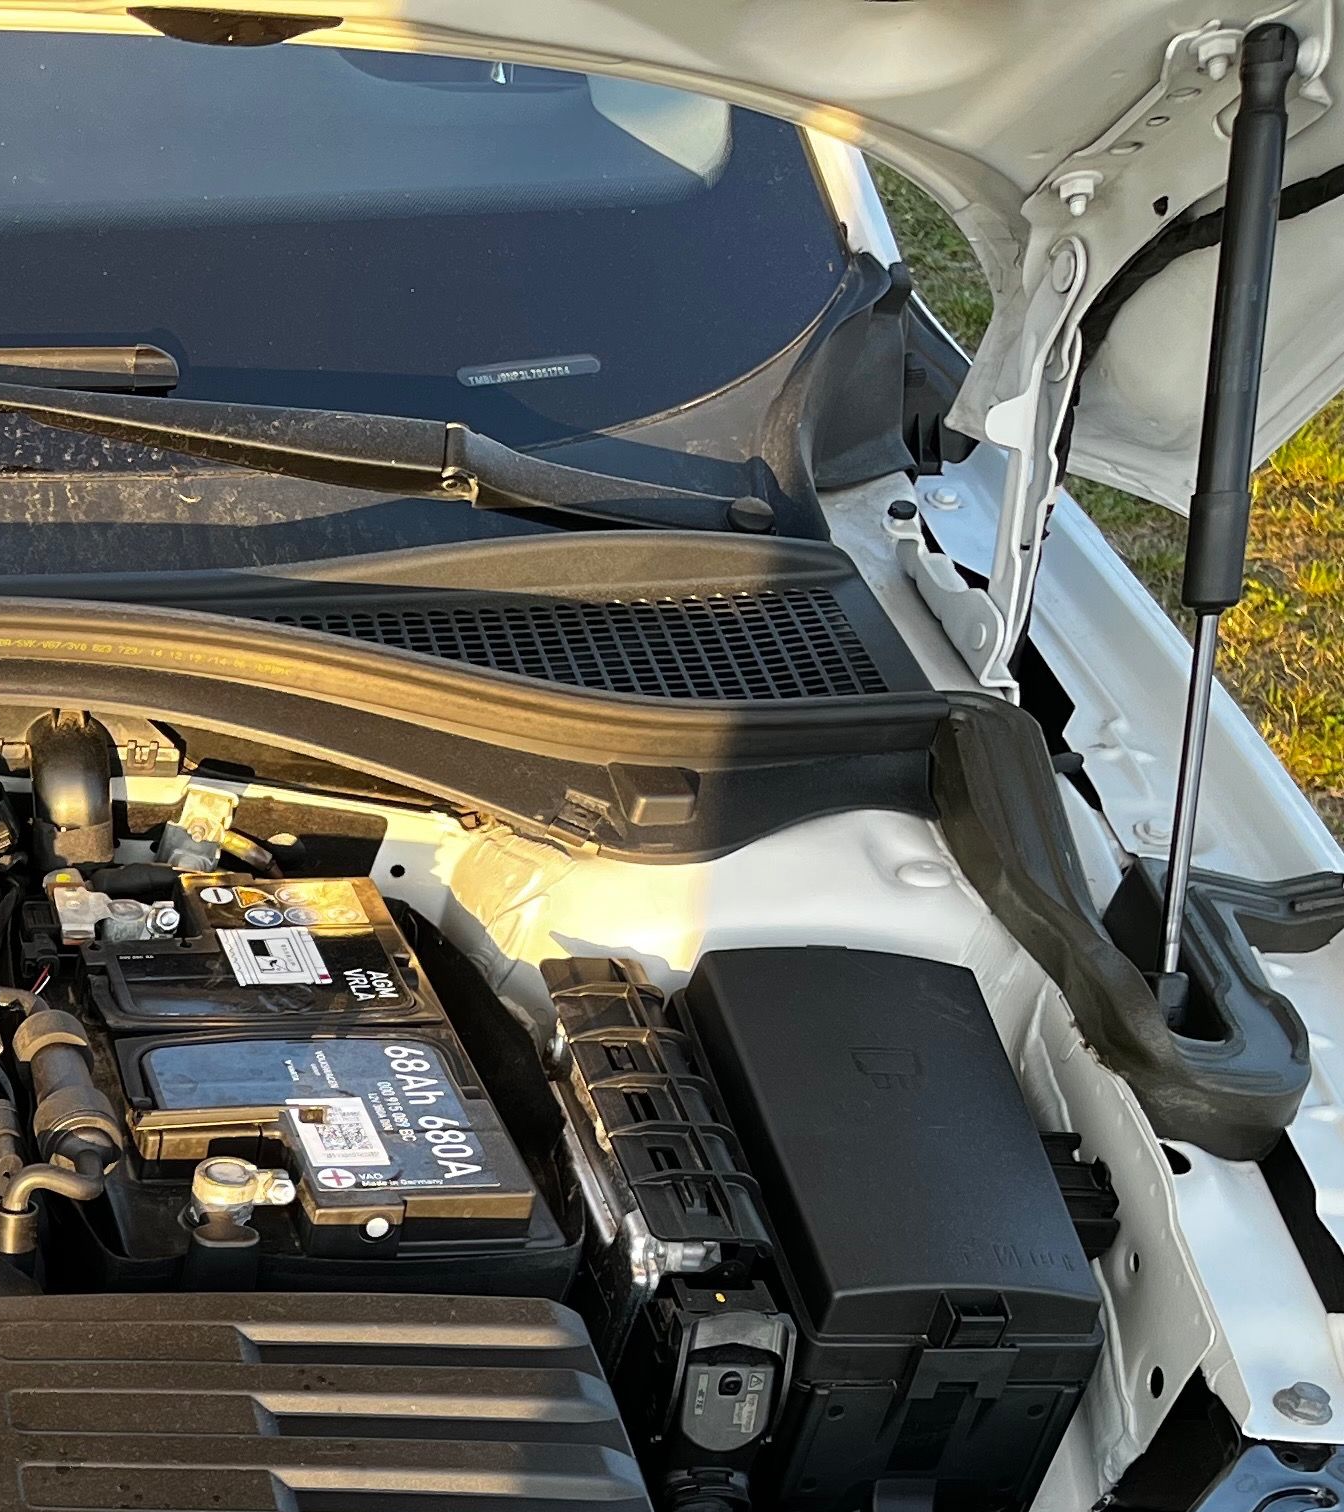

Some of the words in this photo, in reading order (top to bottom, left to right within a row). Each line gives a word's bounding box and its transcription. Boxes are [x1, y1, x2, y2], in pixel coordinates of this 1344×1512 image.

[343, 968, 376, 1002] VRLA
[366, 971, 399, 998] AGM
[384, 1045, 445, 1105] 68Ah
[418, 1115, 482, 1179] 680A
[386, 1096, 403, 1112] 915
[400, 1178, 444, 1187] Germany
